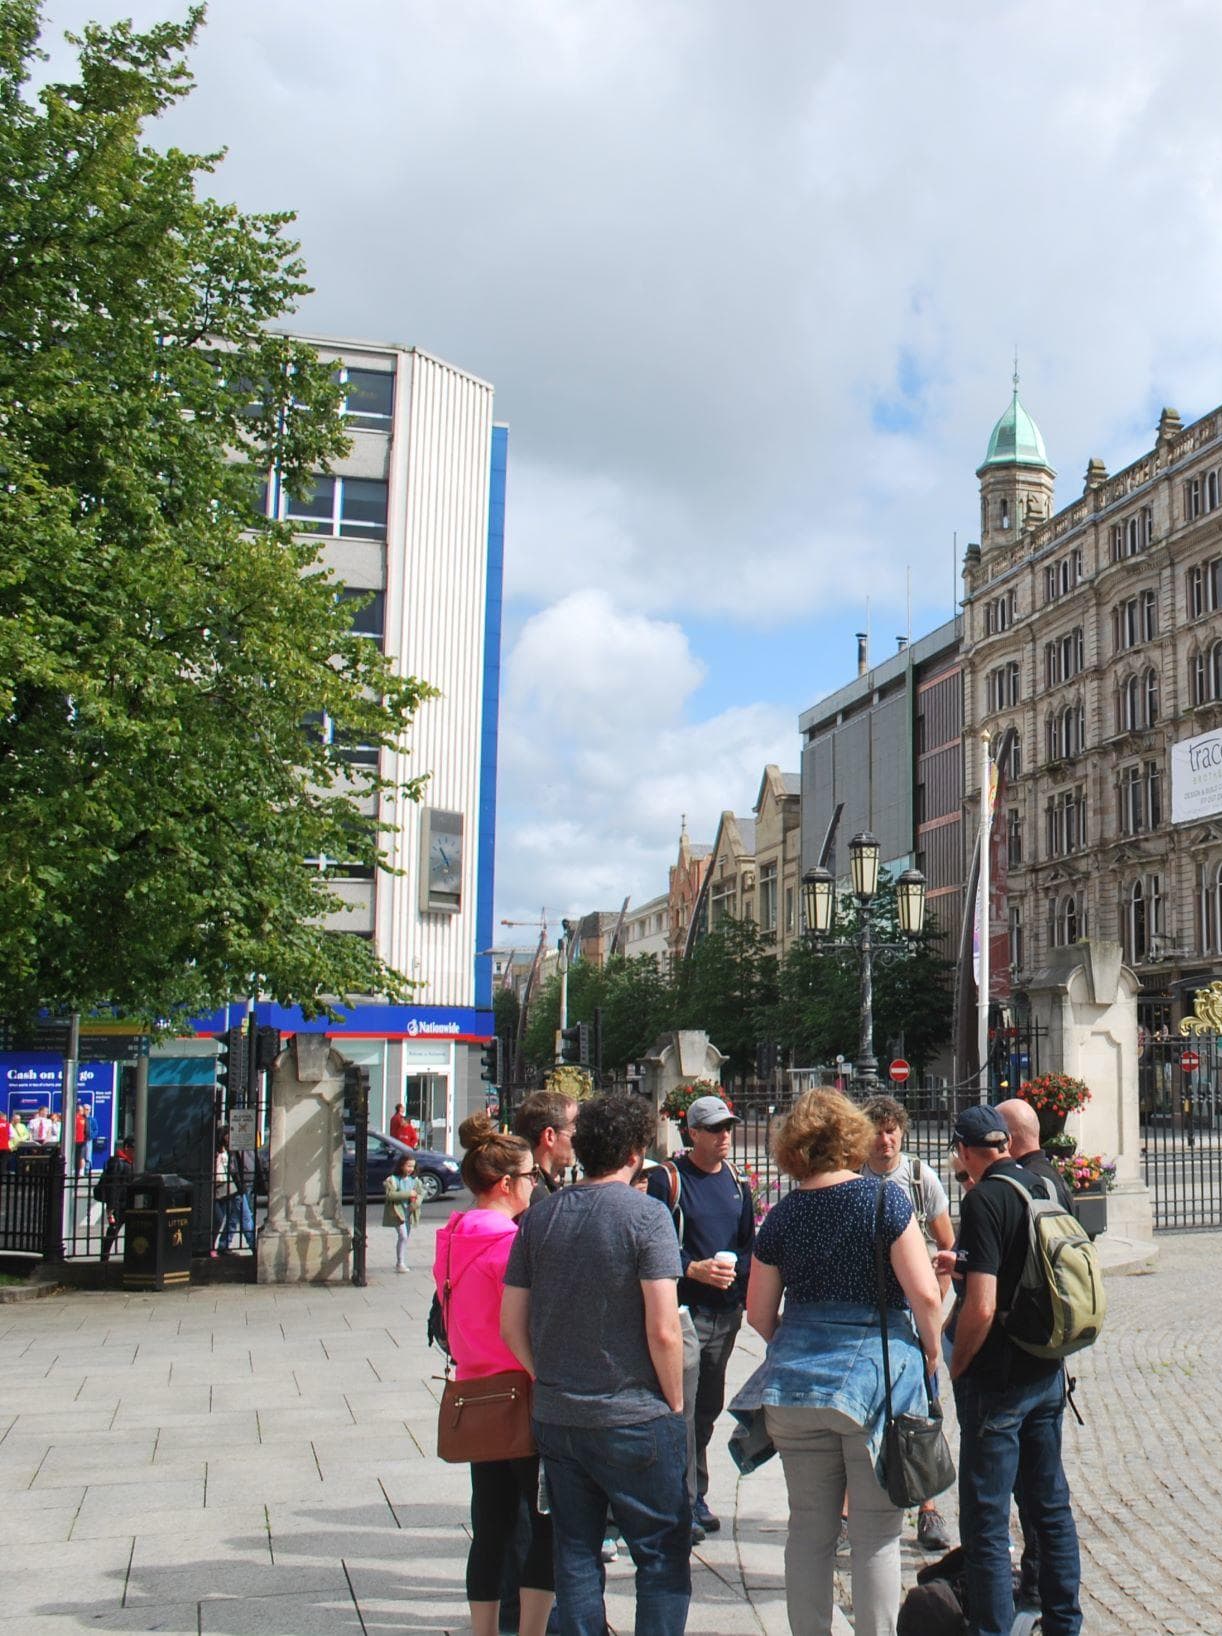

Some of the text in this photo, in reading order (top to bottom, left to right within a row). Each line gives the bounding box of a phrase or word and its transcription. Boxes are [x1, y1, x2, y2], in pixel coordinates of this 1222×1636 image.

[419, 1021, 460, 1034] Nationwide
[7, 1069, 37, 1080] Cash
[39, 1071, 55, 1080] on
[79, 1070, 94, 1081] go
